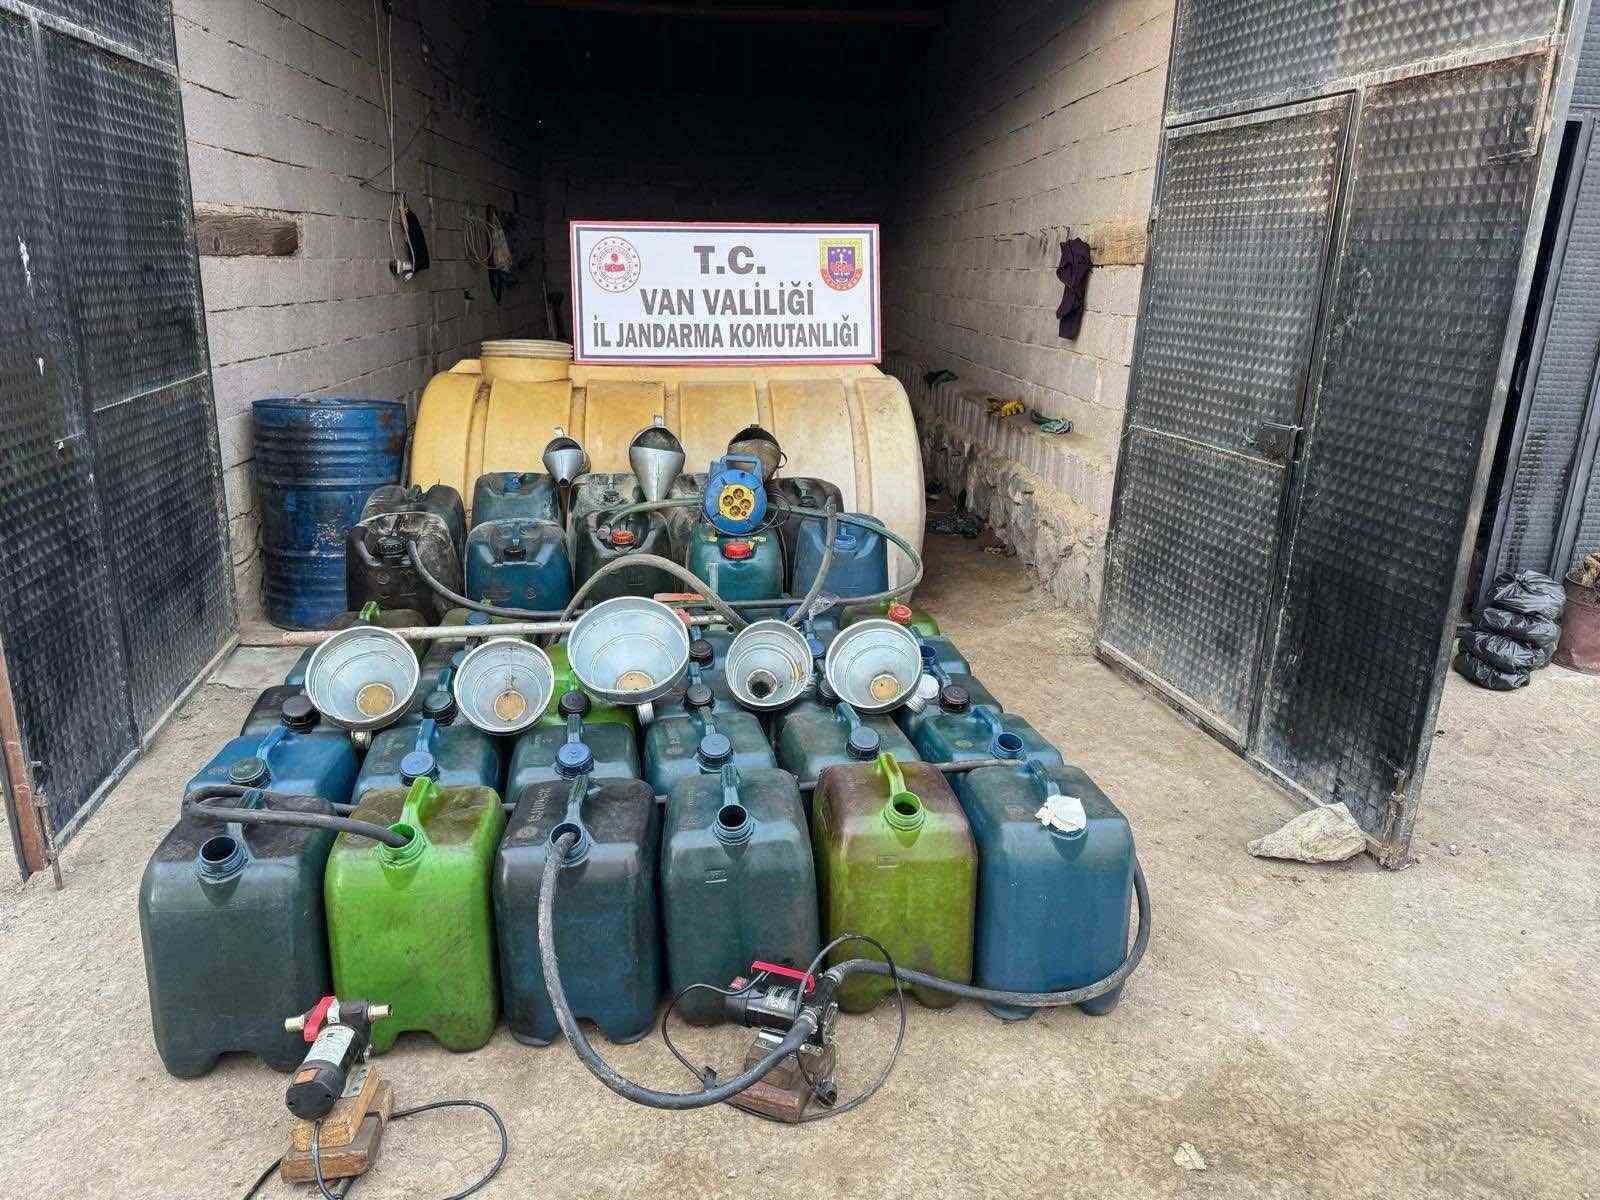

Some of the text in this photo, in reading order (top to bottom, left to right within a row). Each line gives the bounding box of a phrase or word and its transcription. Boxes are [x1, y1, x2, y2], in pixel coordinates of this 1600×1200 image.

[693, 245, 766, 275] T.C.
[640, 280, 815, 316] VAN VALİLİĞİ
[593, 314, 859, 348] İL JANDARMA KOMUTANLIĞI
